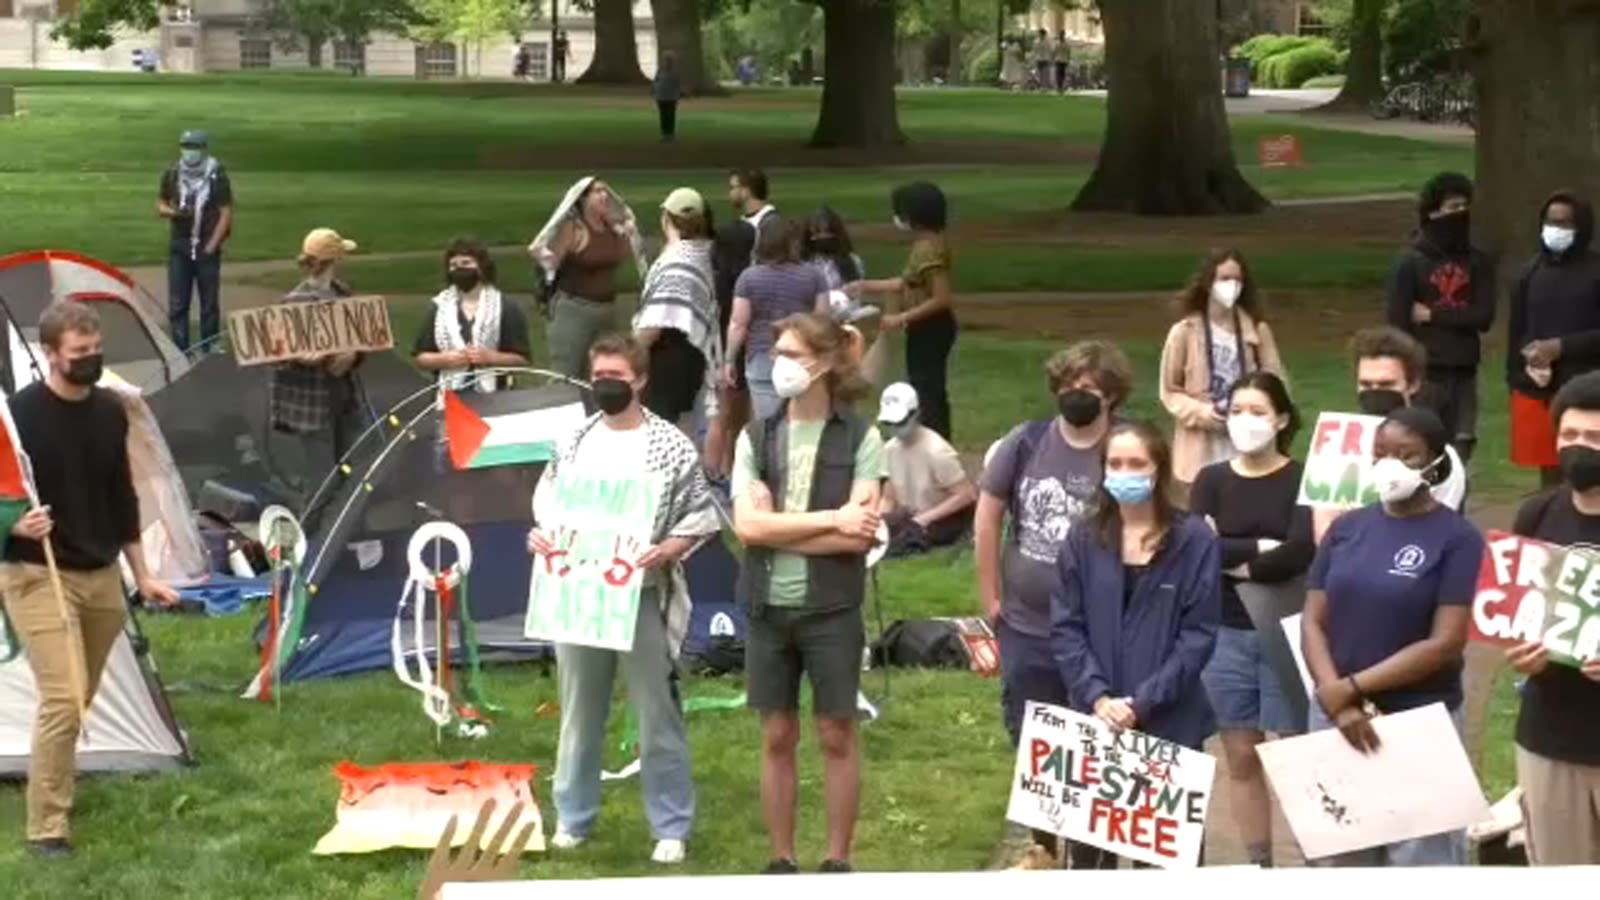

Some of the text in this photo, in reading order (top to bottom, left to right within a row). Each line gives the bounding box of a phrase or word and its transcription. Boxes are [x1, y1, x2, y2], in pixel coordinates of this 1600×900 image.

[1021, 772, 1081, 808] WILL BE
[1030, 737, 1205, 824] PALESTINE
[1088, 797, 1179, 858] FREE
